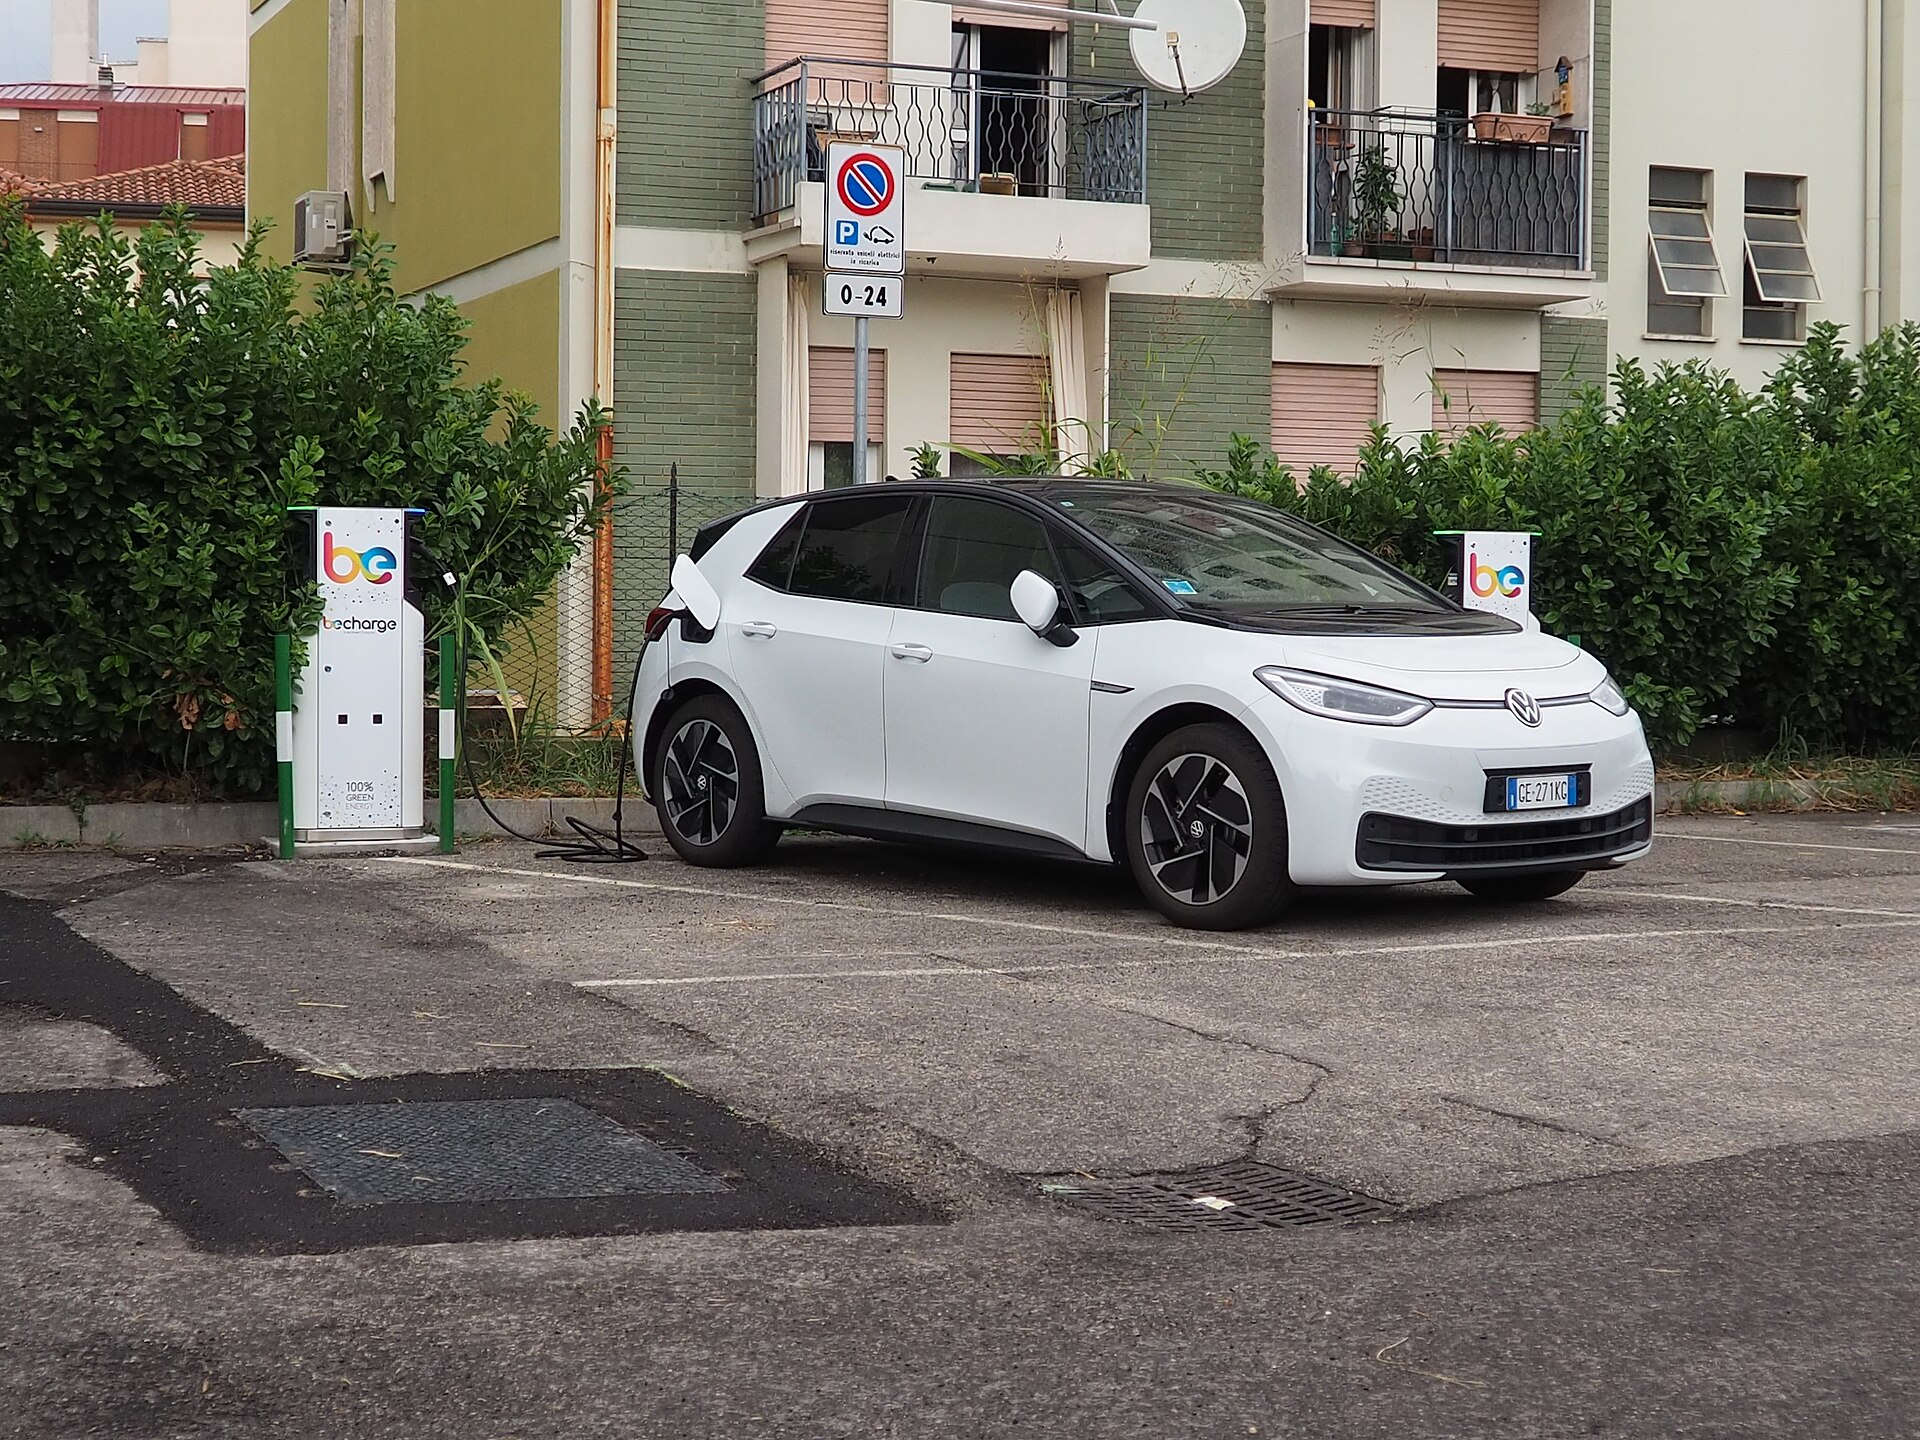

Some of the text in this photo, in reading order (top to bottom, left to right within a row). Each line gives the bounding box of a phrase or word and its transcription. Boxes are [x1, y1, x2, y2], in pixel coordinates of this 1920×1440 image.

[840, 222, 855, 243] P
[877, 251, 900, 259] elettrici
[841, 284, 887, 307] 0-24
[323, 531, 397, 585] be
[1469, 552, 1525, 598] be
[322, 615, 397, 633] becharge
[345, 781, 374, 792] 100%
[1518, 783, 1532, 803] GE
[1535, 780, 1567, 802] 271KG
[345, 793, 375, 801] GREEN
[345, 802, 374, 810] ENERGY
